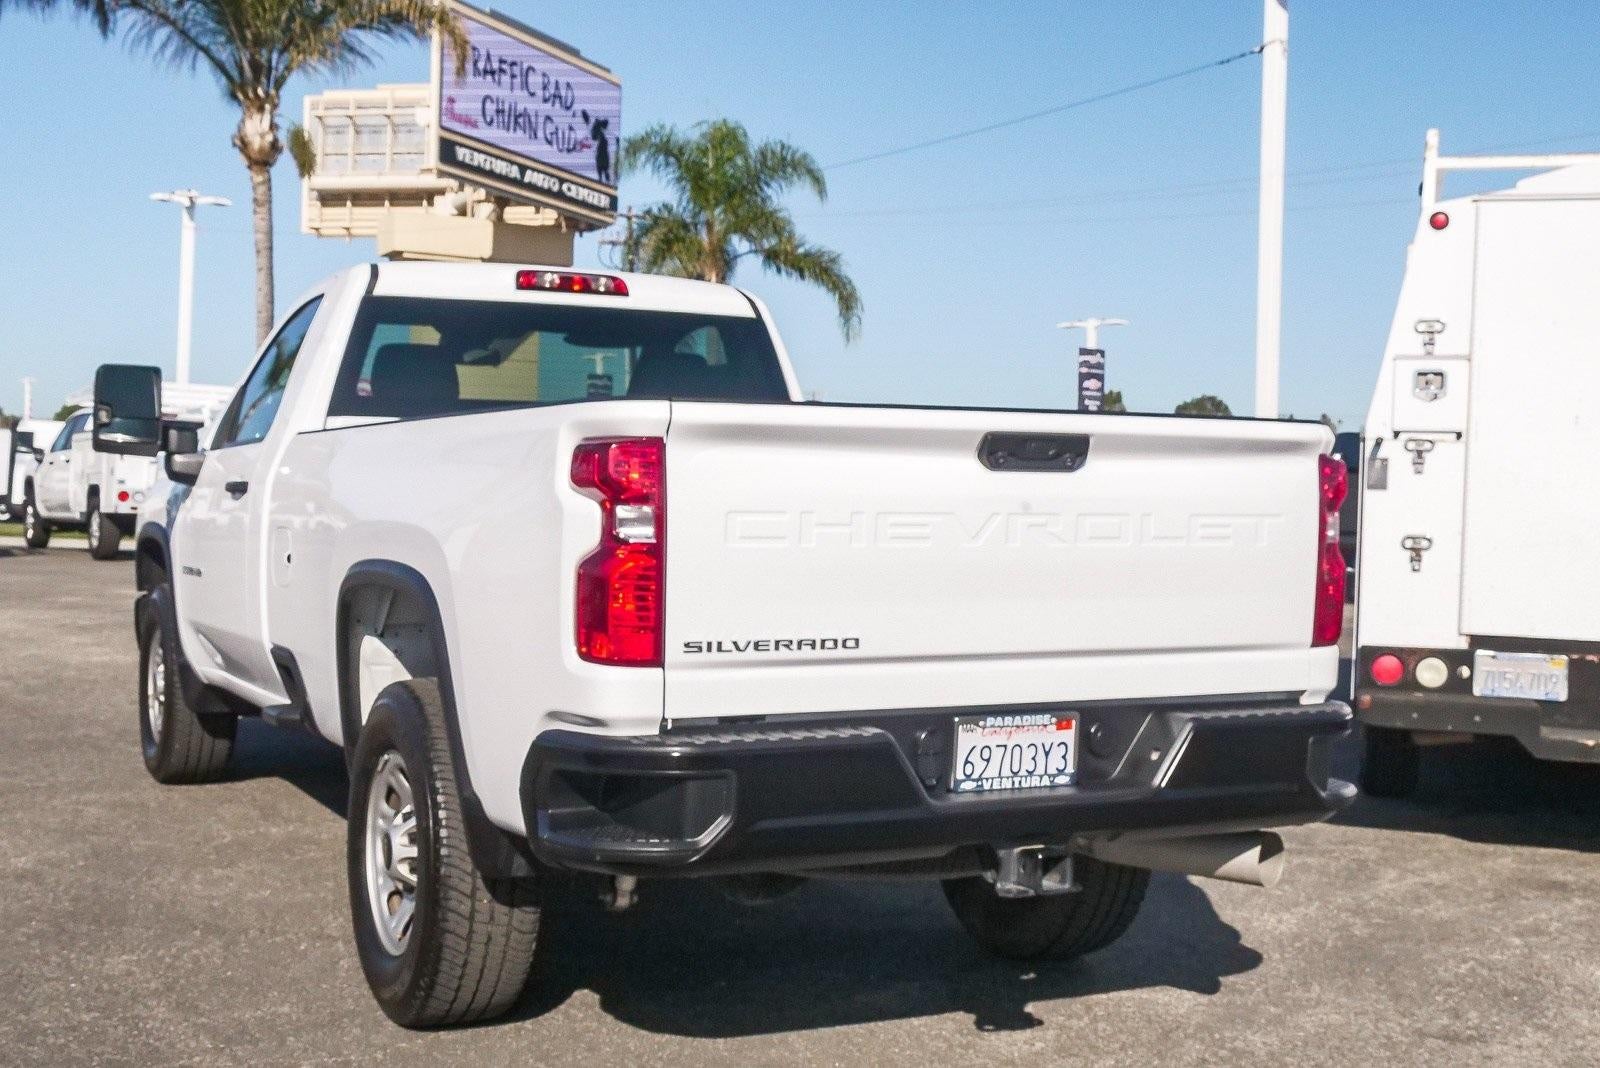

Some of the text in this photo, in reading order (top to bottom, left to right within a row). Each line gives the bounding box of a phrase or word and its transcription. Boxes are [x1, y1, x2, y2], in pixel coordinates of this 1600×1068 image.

[471, 45, 536, 97] RAFFIC
[455, 145, 611, 209] VENTURA AUTO CENTER
[723, 509, 1286, 549] CHEVROLET
[683, 637, 860, 654] SILVERADO
[962, 741, 1069, 778] 69703Y3
[982, 775, 1052, 790] VENTURA
